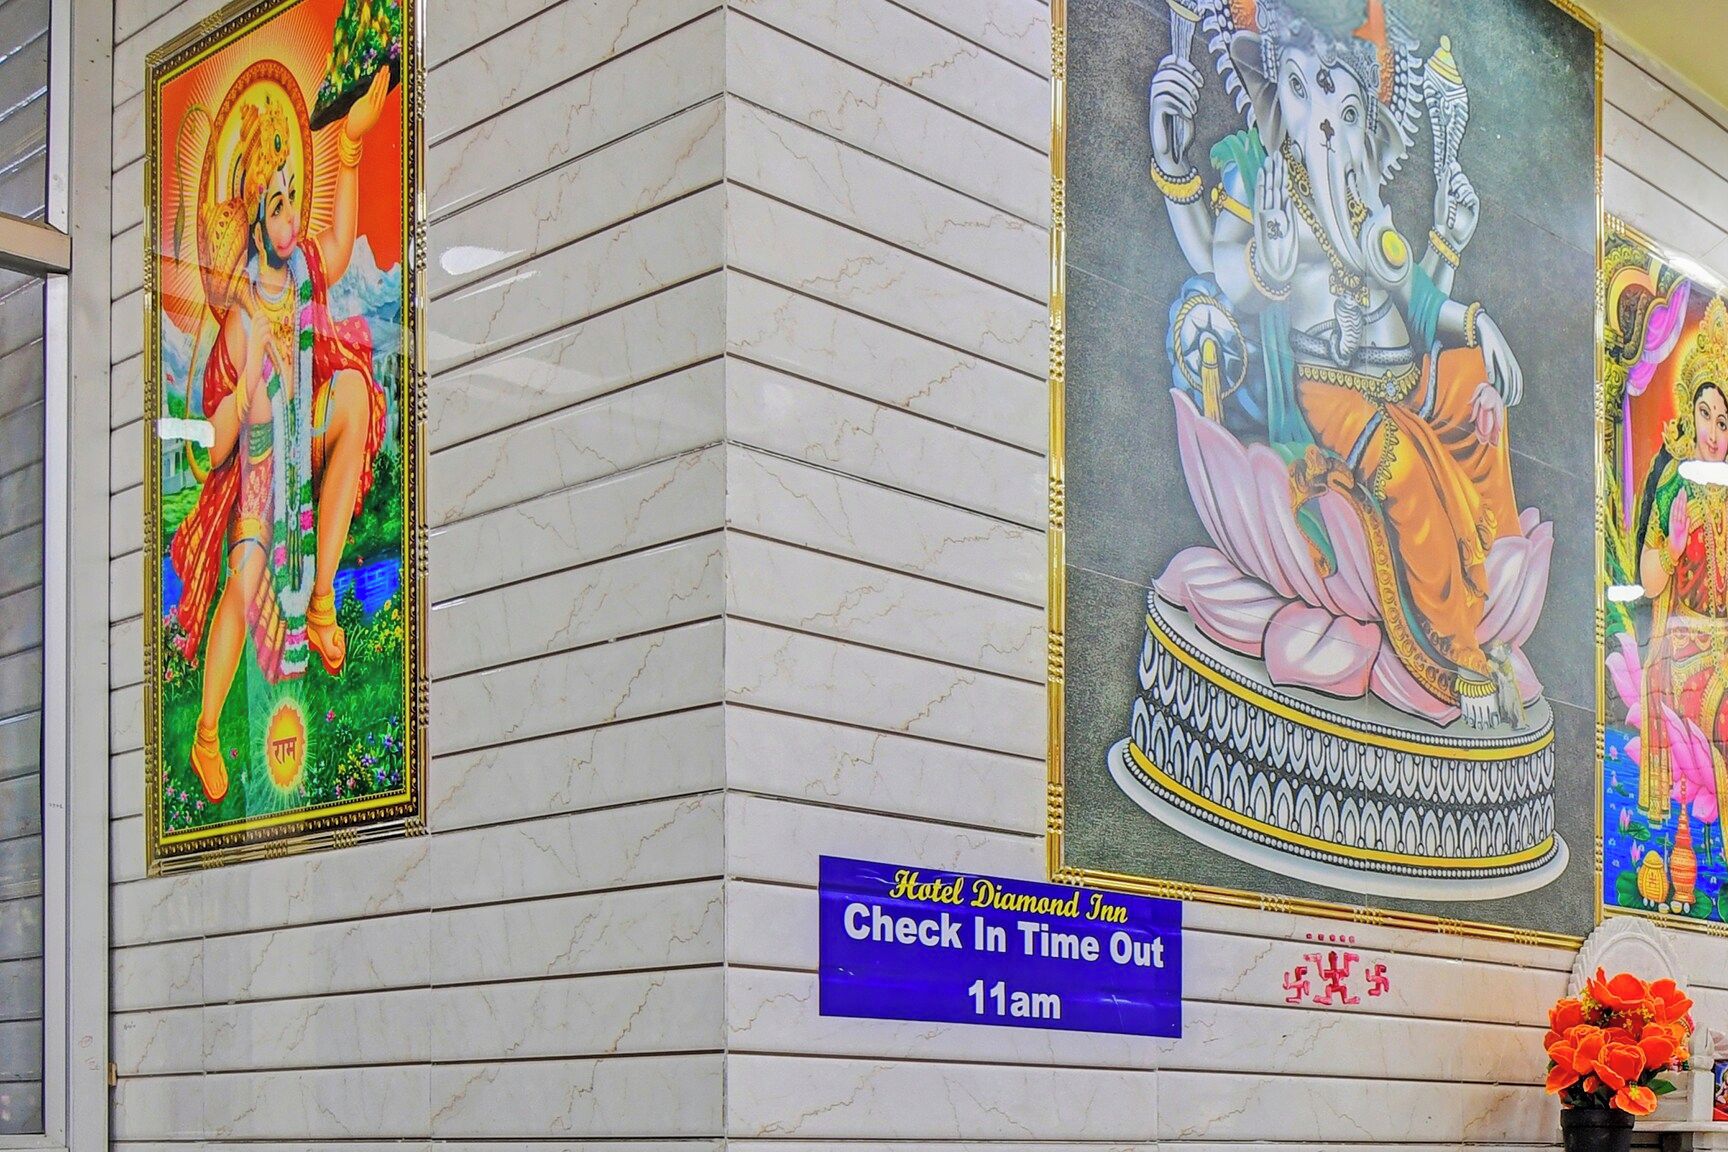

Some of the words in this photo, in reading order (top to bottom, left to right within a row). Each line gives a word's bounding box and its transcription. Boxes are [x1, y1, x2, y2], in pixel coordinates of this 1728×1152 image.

[272, 736, 298, 765] राम
[889, 869, 964, 905] Hotel
[970, 879, 1080, 919] Diamond
[1085, 893, 1129, 924] Inn
[843, 902, 963, 949] Check
[974, 916, 1006, 953] In
[1017, 920, 1100, 962] Time
[1109, 930, 1165, 968] Out
[968, 979, 1062, 1020] 11am
